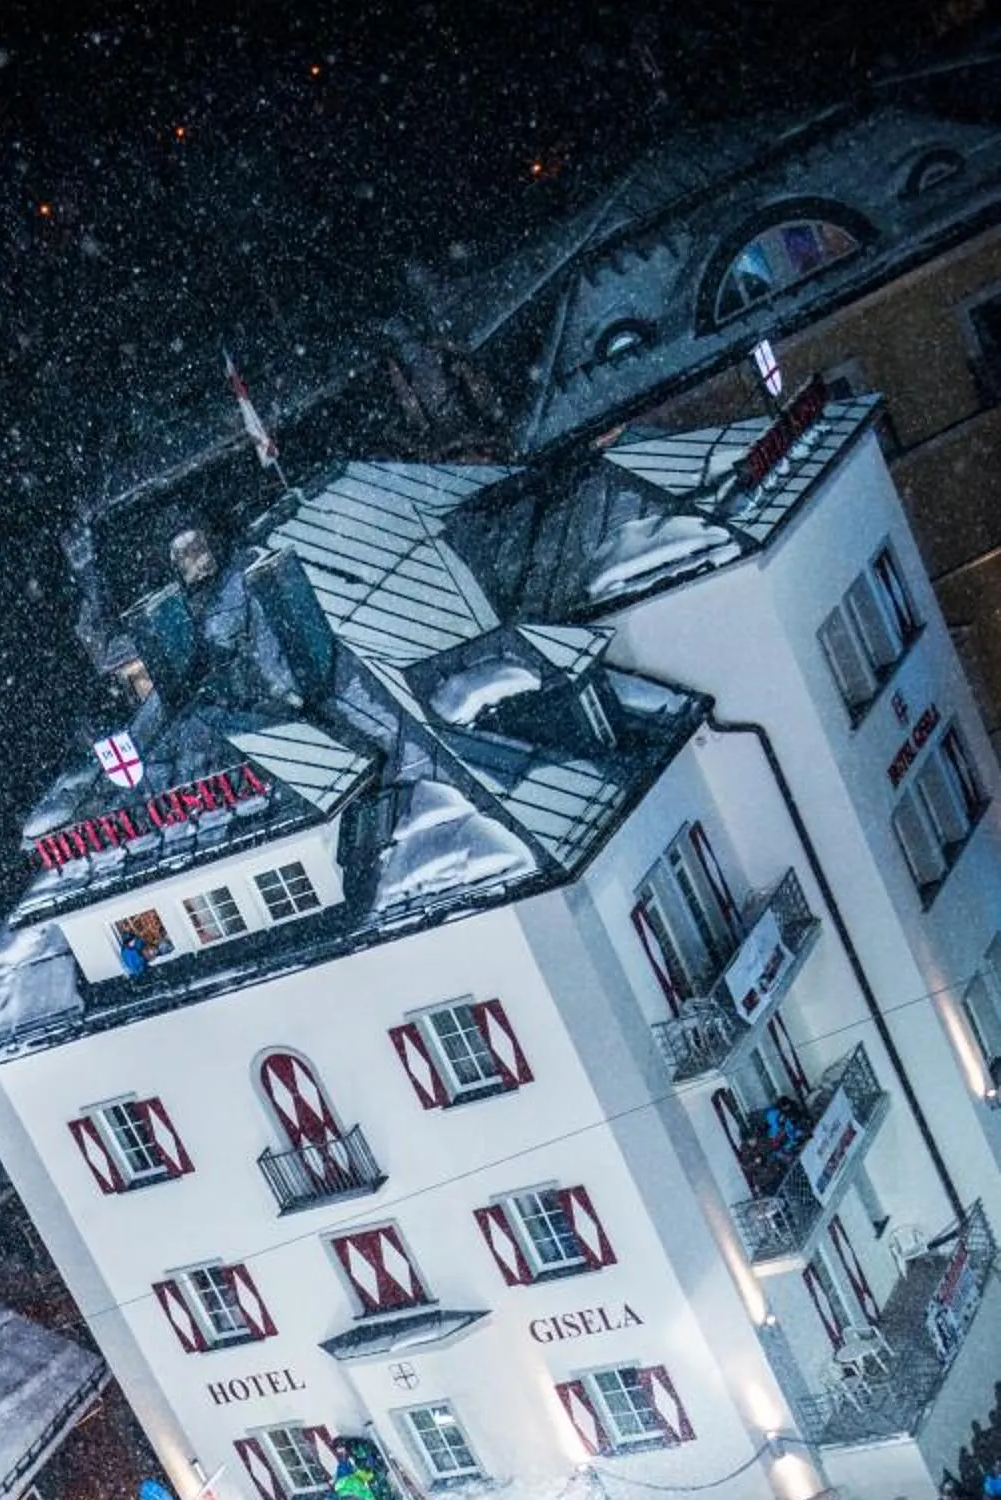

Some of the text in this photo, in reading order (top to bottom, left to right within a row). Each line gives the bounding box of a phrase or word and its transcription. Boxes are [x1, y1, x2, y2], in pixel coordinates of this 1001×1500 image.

[33, 808, 147, 869] HOTEL
[207, 1303, 644, 1405] HOTEL GISELA
